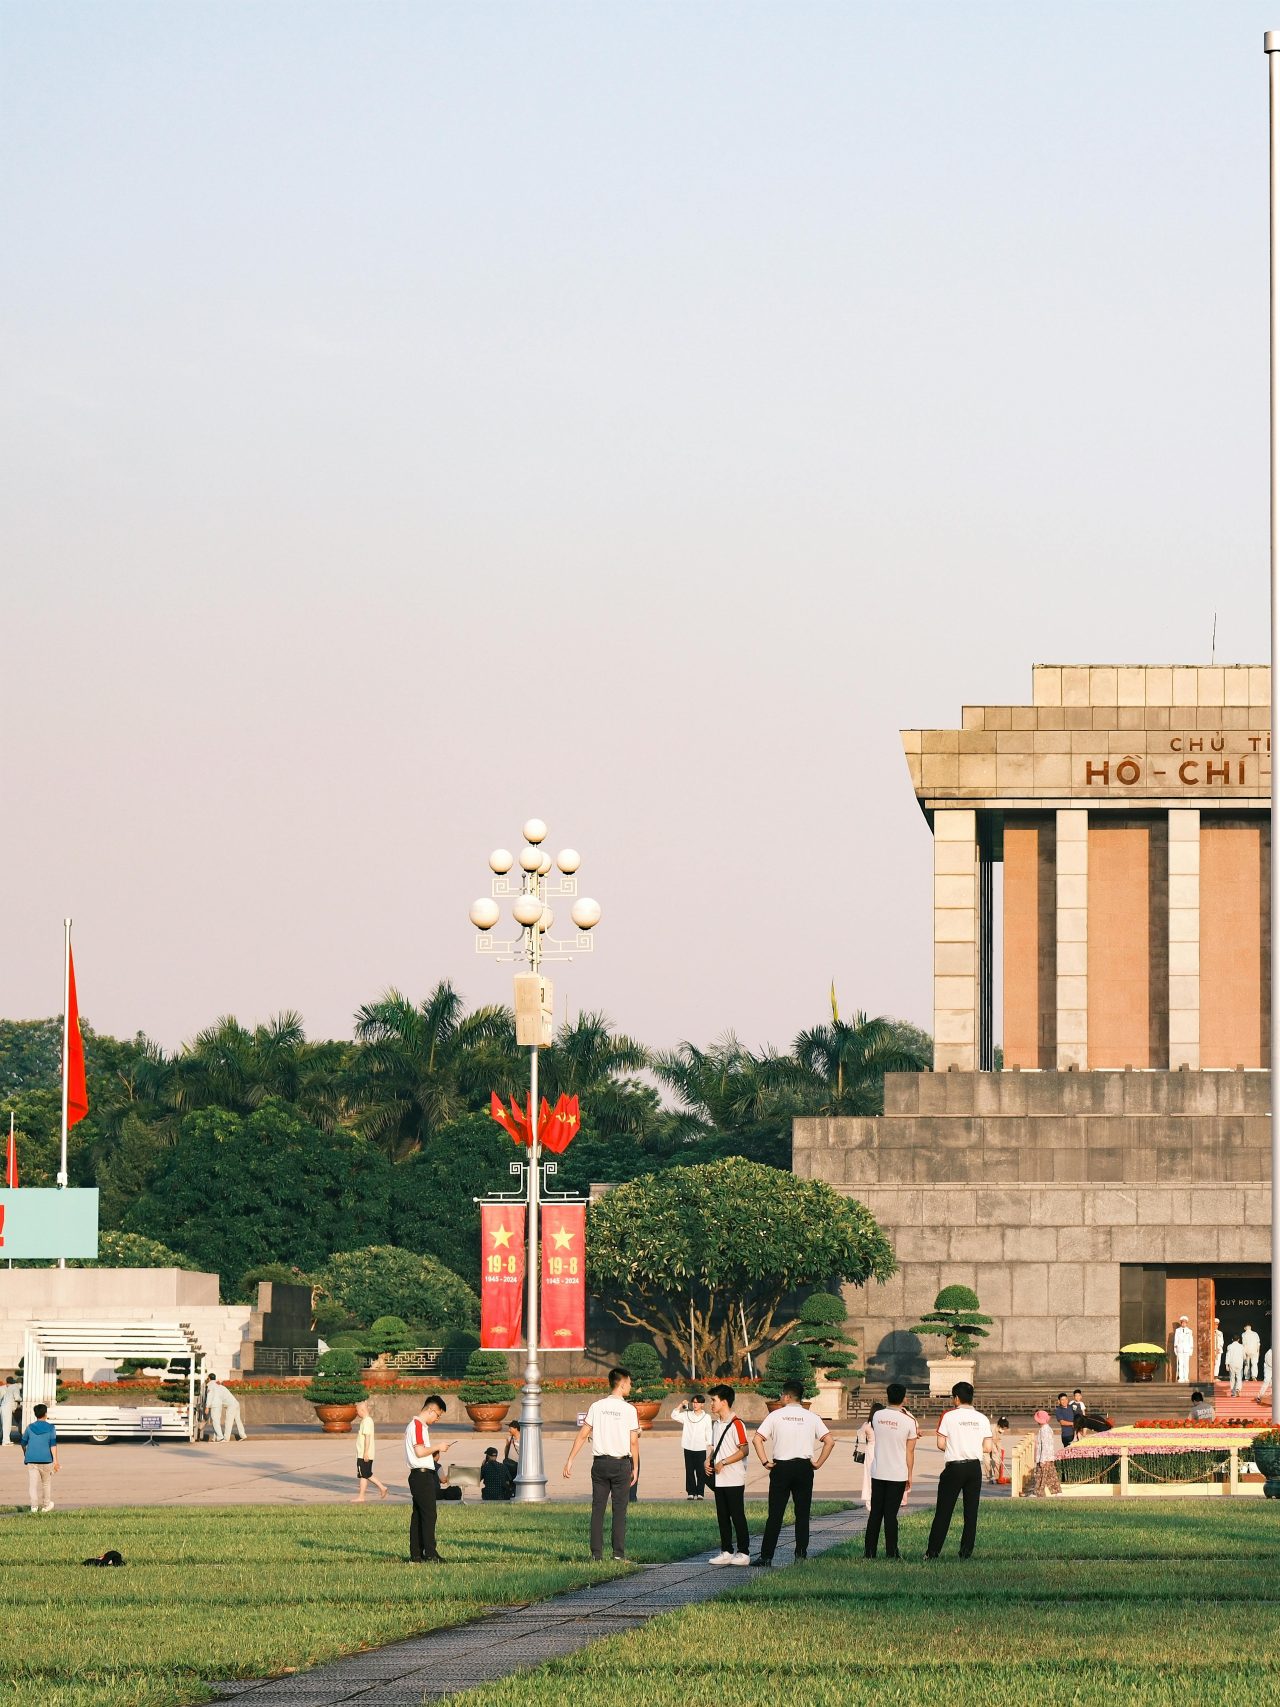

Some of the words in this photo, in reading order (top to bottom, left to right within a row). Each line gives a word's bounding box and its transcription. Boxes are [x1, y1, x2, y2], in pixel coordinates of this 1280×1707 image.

[1170, 732, 1225, 751] CHỦ
[1086, 754, 1143, 785] HỒ
[1178, 754, 1249, 785] CHÍ
[487, 1255, 516, 1274] 19-8
[548, 1256, 578, 1275] 19-8
[485, 1275, 499, 1283] 1945
[565, 1277, 579, 1285] 2024
